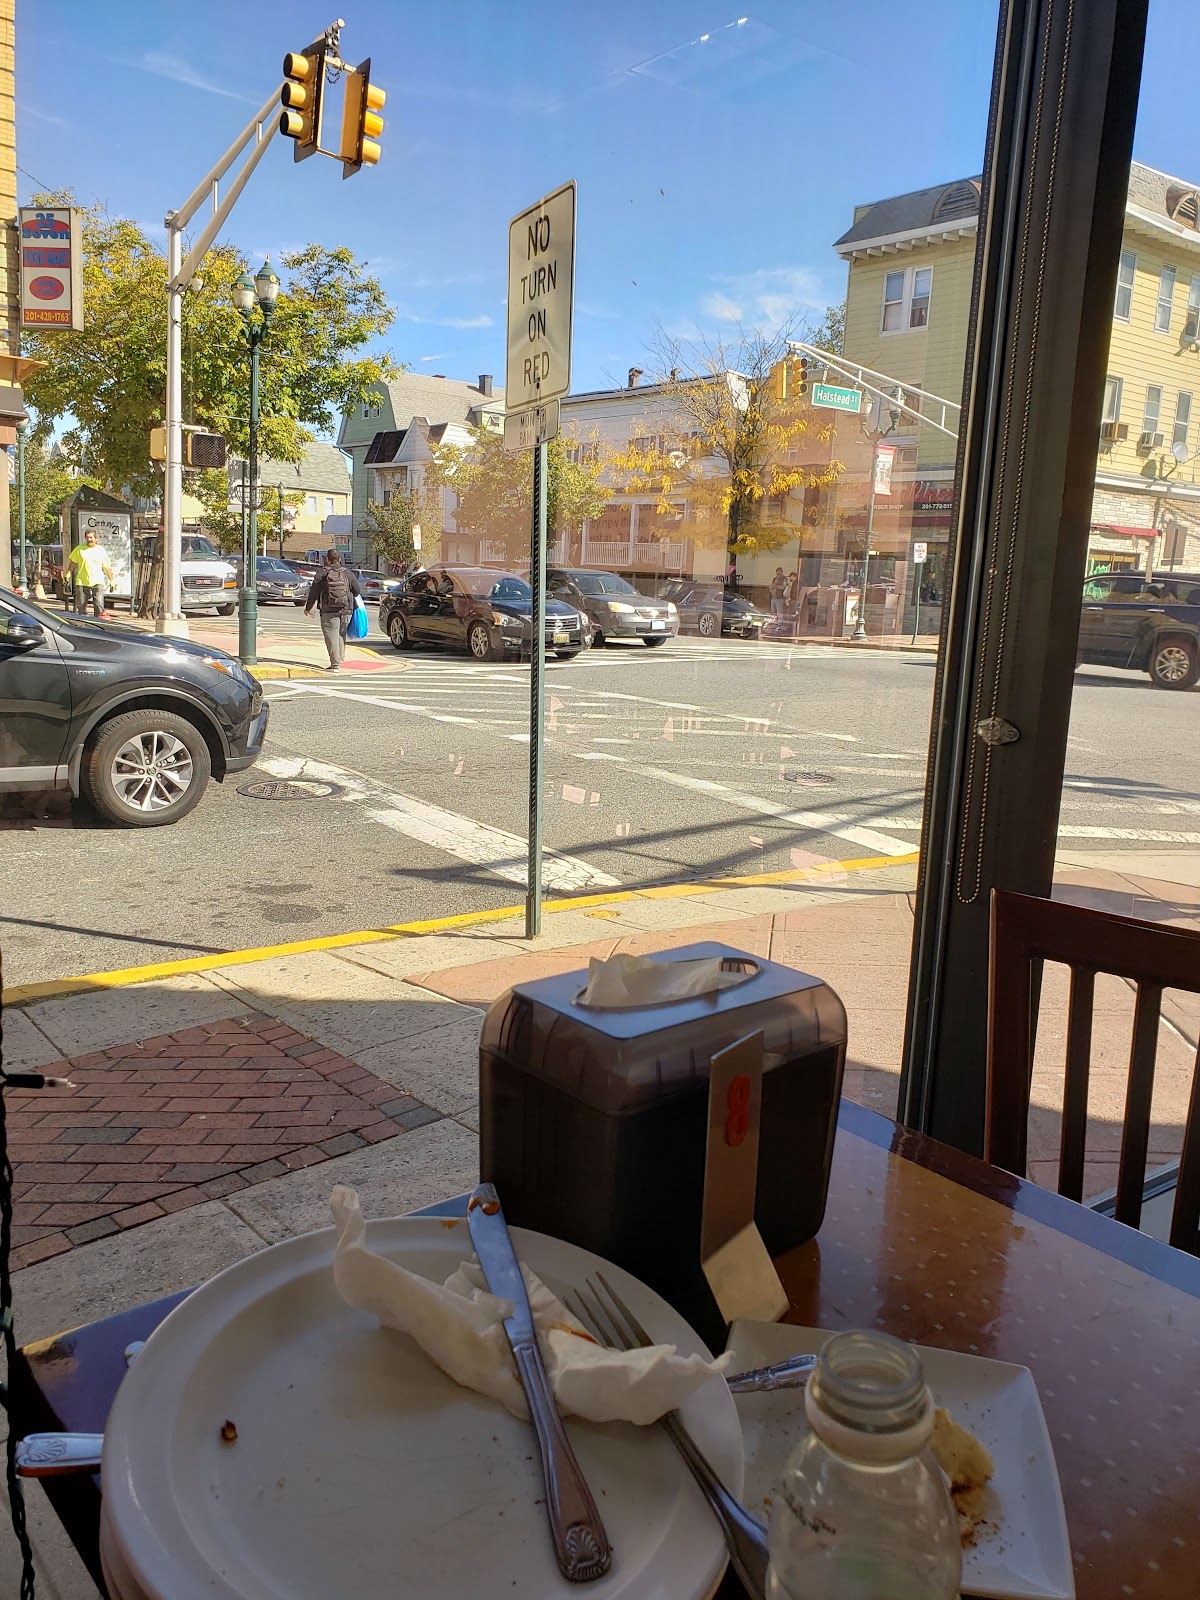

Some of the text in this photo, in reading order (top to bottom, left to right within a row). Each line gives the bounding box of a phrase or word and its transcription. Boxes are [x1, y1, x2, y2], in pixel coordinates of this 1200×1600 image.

[22, 228, 69, 239] Seven
[35, 213, 55, 228] 25
[528, 215, 550, 260] NO
[521, 260, 557, 304] TURN
[528, 309, 546, 343] ON
[523, 351, 550, 386] RED
[817, 389, 850, 405] Halstead
[112, 526, 119, 534] 21
[723, 1074, 750, 1147] 8
